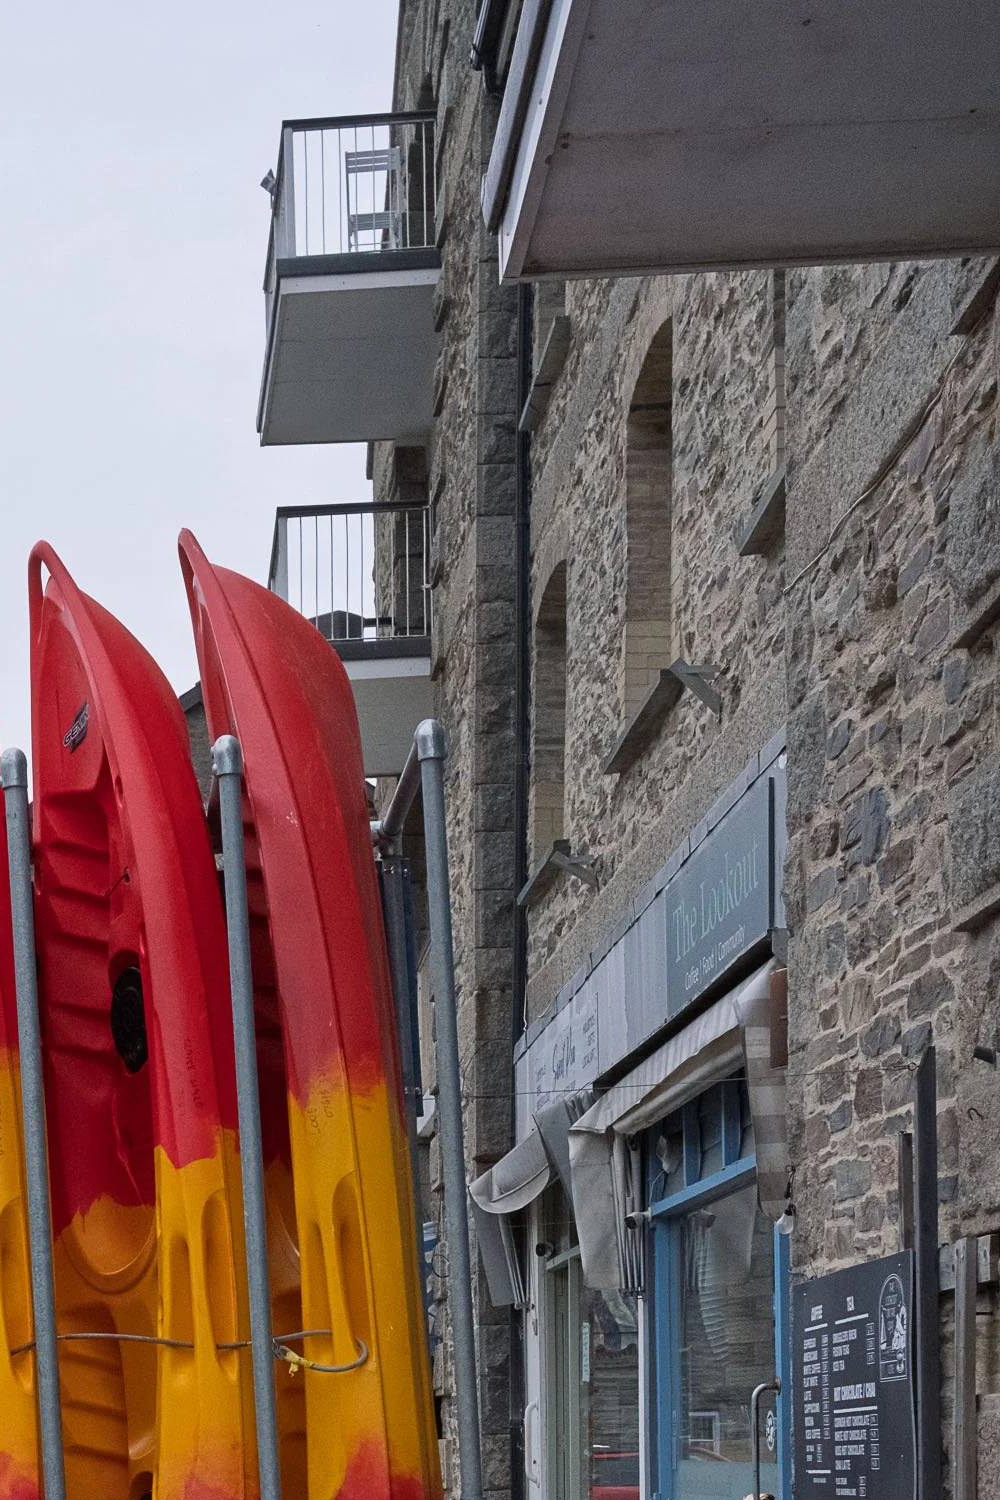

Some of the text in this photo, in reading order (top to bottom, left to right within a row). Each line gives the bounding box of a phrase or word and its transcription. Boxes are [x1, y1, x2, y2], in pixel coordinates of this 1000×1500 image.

[673, 840, 759, 963] The Lookout
[685, 925, 745, 990] Coffee Food Community
[847, 1296, 855, 1312] TEA
[811, 1304, 822, 1321] COFFEE
[804, 1391, 812, 1400] LATTE
[841, 1384, 862, 1400] CHOCOLATE
[852, 1415, 870, 1426] CHOCOLATE
[849, 1429, 867, 1440] CHOCOLATE
[848, 1444, 865, 1455] CHOCOLATE
[842, 1460, 851, 1470] LATTE
